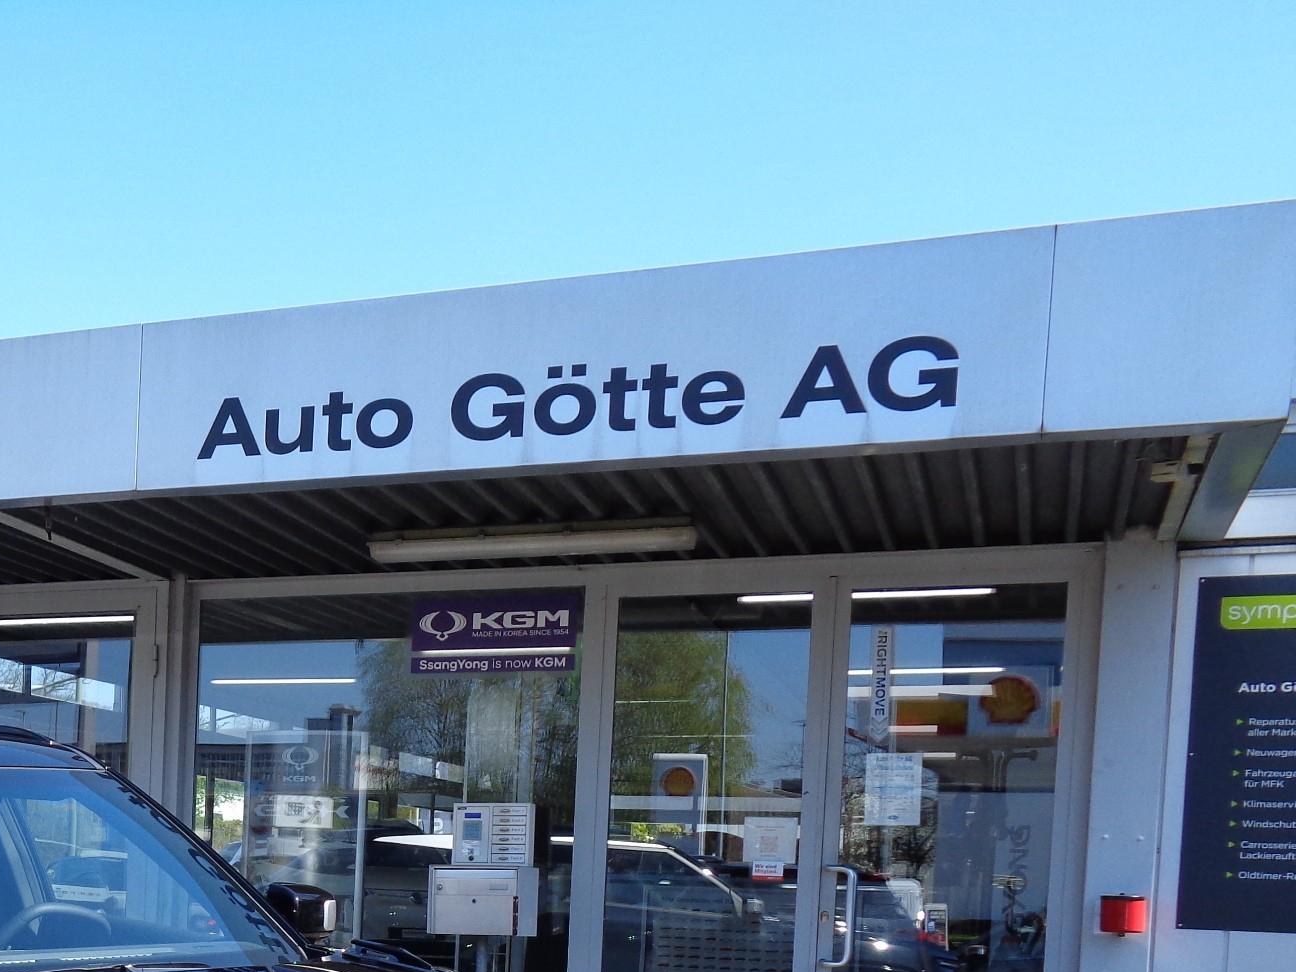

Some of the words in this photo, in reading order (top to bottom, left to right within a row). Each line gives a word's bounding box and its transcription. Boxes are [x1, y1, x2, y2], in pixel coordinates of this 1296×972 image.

[196, 391, 414, 460] Auto
[450, 363, 745, 441] Götte
[779, 335, 960, 419] AG
[472, 609, 570, 630] KGM
[419, 659, 488, 672] SsangYong
[492, 658, 502, 669] is
[505, 659, 532, 669] now
[534, 657, 566, 668] KGM
[1238, 682, 1276, 693] Auto
[1280, 682, 1296, 692] G
[1248, 718, 1296, 726] Reparatu
[1248, 728, 1270, 736] aller
[283, 775, 316, 783] KGM
[1244, 780, 1260, 788] für
[1261, 780, 1284, 788] MFK
